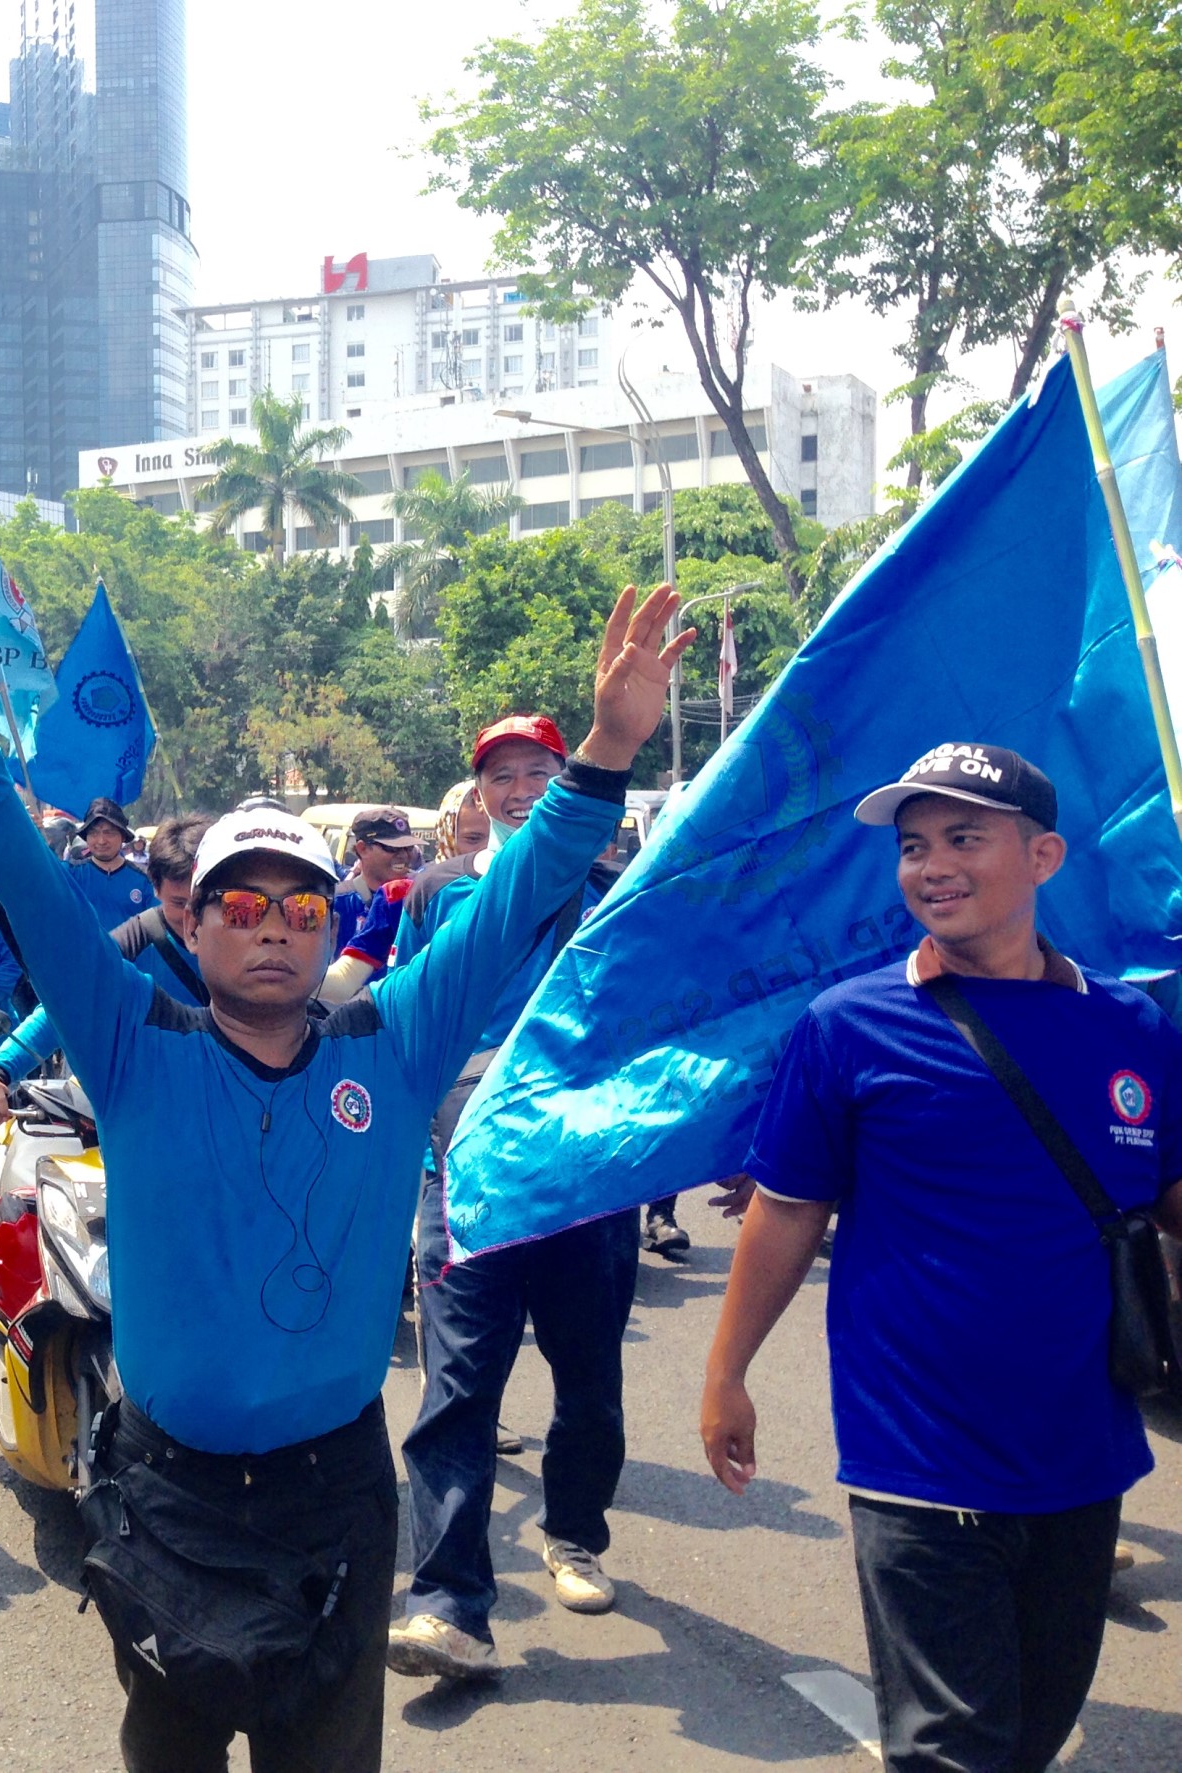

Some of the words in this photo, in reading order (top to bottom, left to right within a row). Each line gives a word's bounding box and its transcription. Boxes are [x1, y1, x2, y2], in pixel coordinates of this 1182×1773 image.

[136, 454, 173, 473] Inna
[916, 743, 989, 764] AGAL
[899, 757, 953, 783] OVE
[960, 759, 1003, 783] ON
